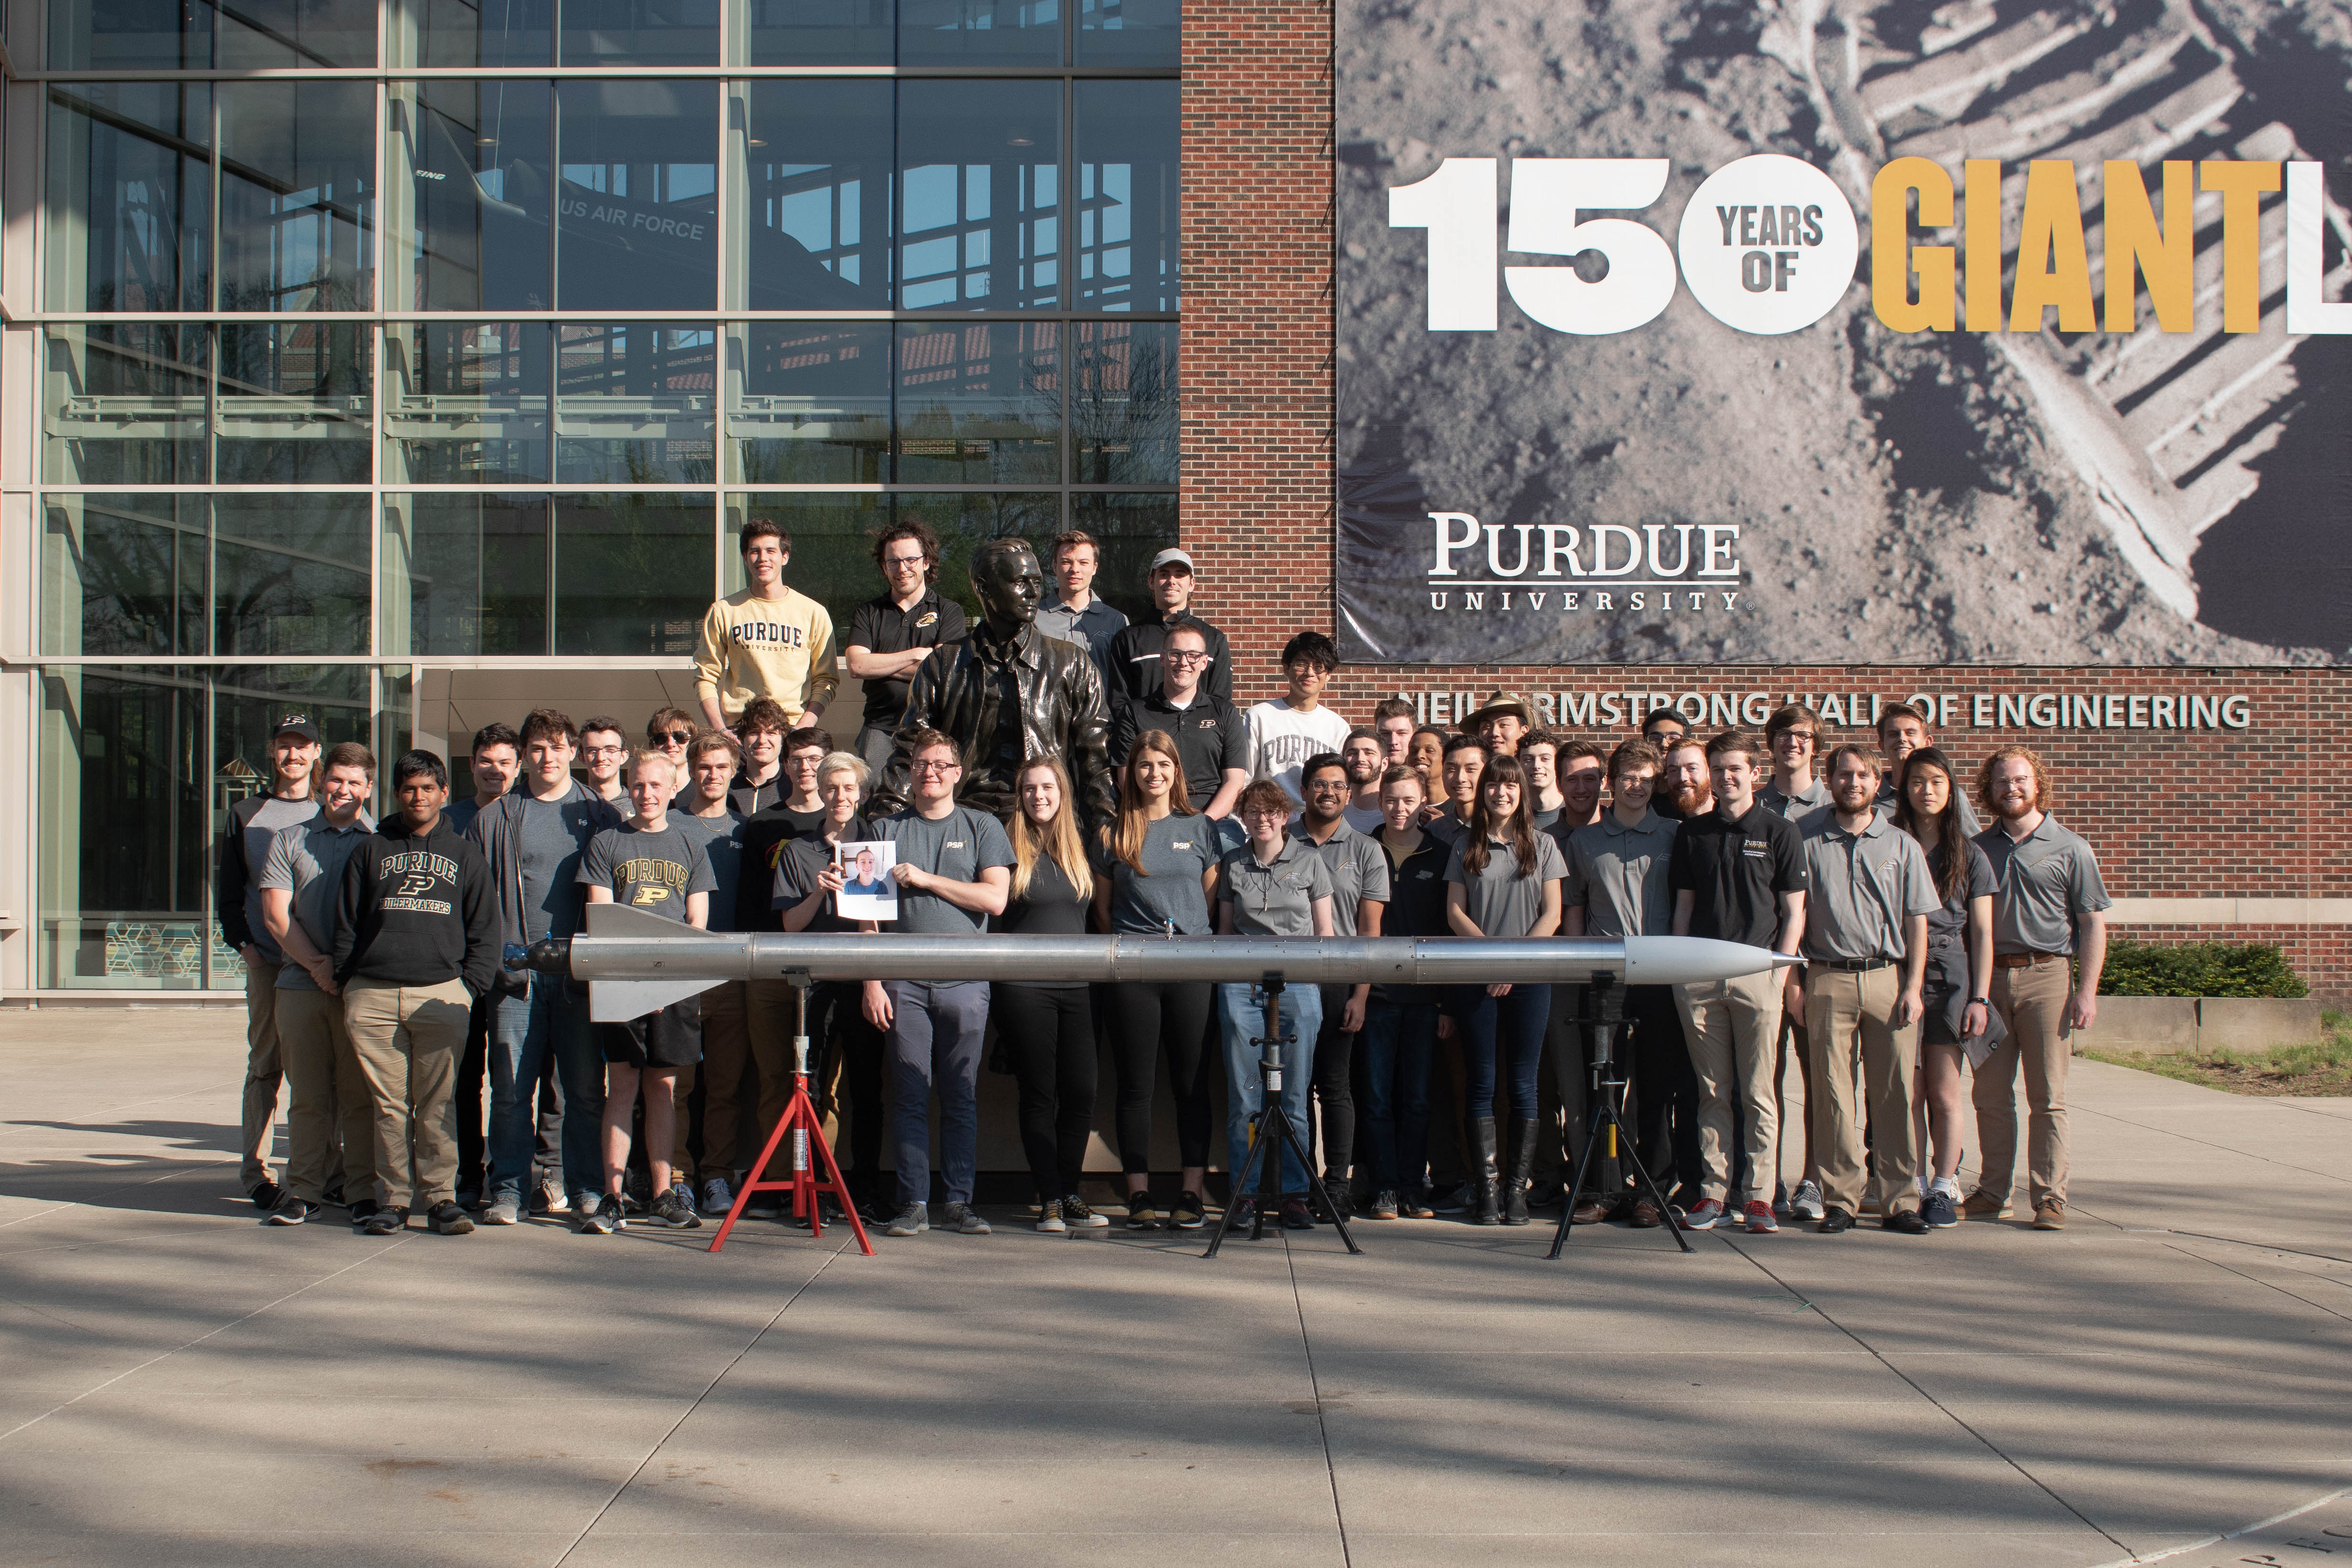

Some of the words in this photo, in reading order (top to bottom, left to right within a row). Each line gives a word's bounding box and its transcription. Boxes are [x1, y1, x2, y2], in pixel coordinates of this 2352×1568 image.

[560, 199, 587, 217] US
[591, 205, 627, 226] AIR
[632, 213, 704, 241] FORCE
[1716, 204, 1823, 246] YEARS
[1871, 156, 2281, 333] GIANT
[1742, 251, 1799, 293] OF
[1428, 512, 1740, 576] PURDUE
[1430, 592, 1738, 611] UNIVERSITY
[732, 622, 802, 648] PURDUE
[1509, 693, 1770, 725] RMSTRONG
[1905, 694, 1958, 726] OF
[1974, 693, 2251, 727] ENGINEERING
[1264, 734, 1337, 772] PURD
[1173, 842, 1190, 850] PSP
[380, 852, 458, 885] PURDUE
[615, 859, 689, 896] PURDUE
[380, 898, 451, 914] BOILERMAKERS
